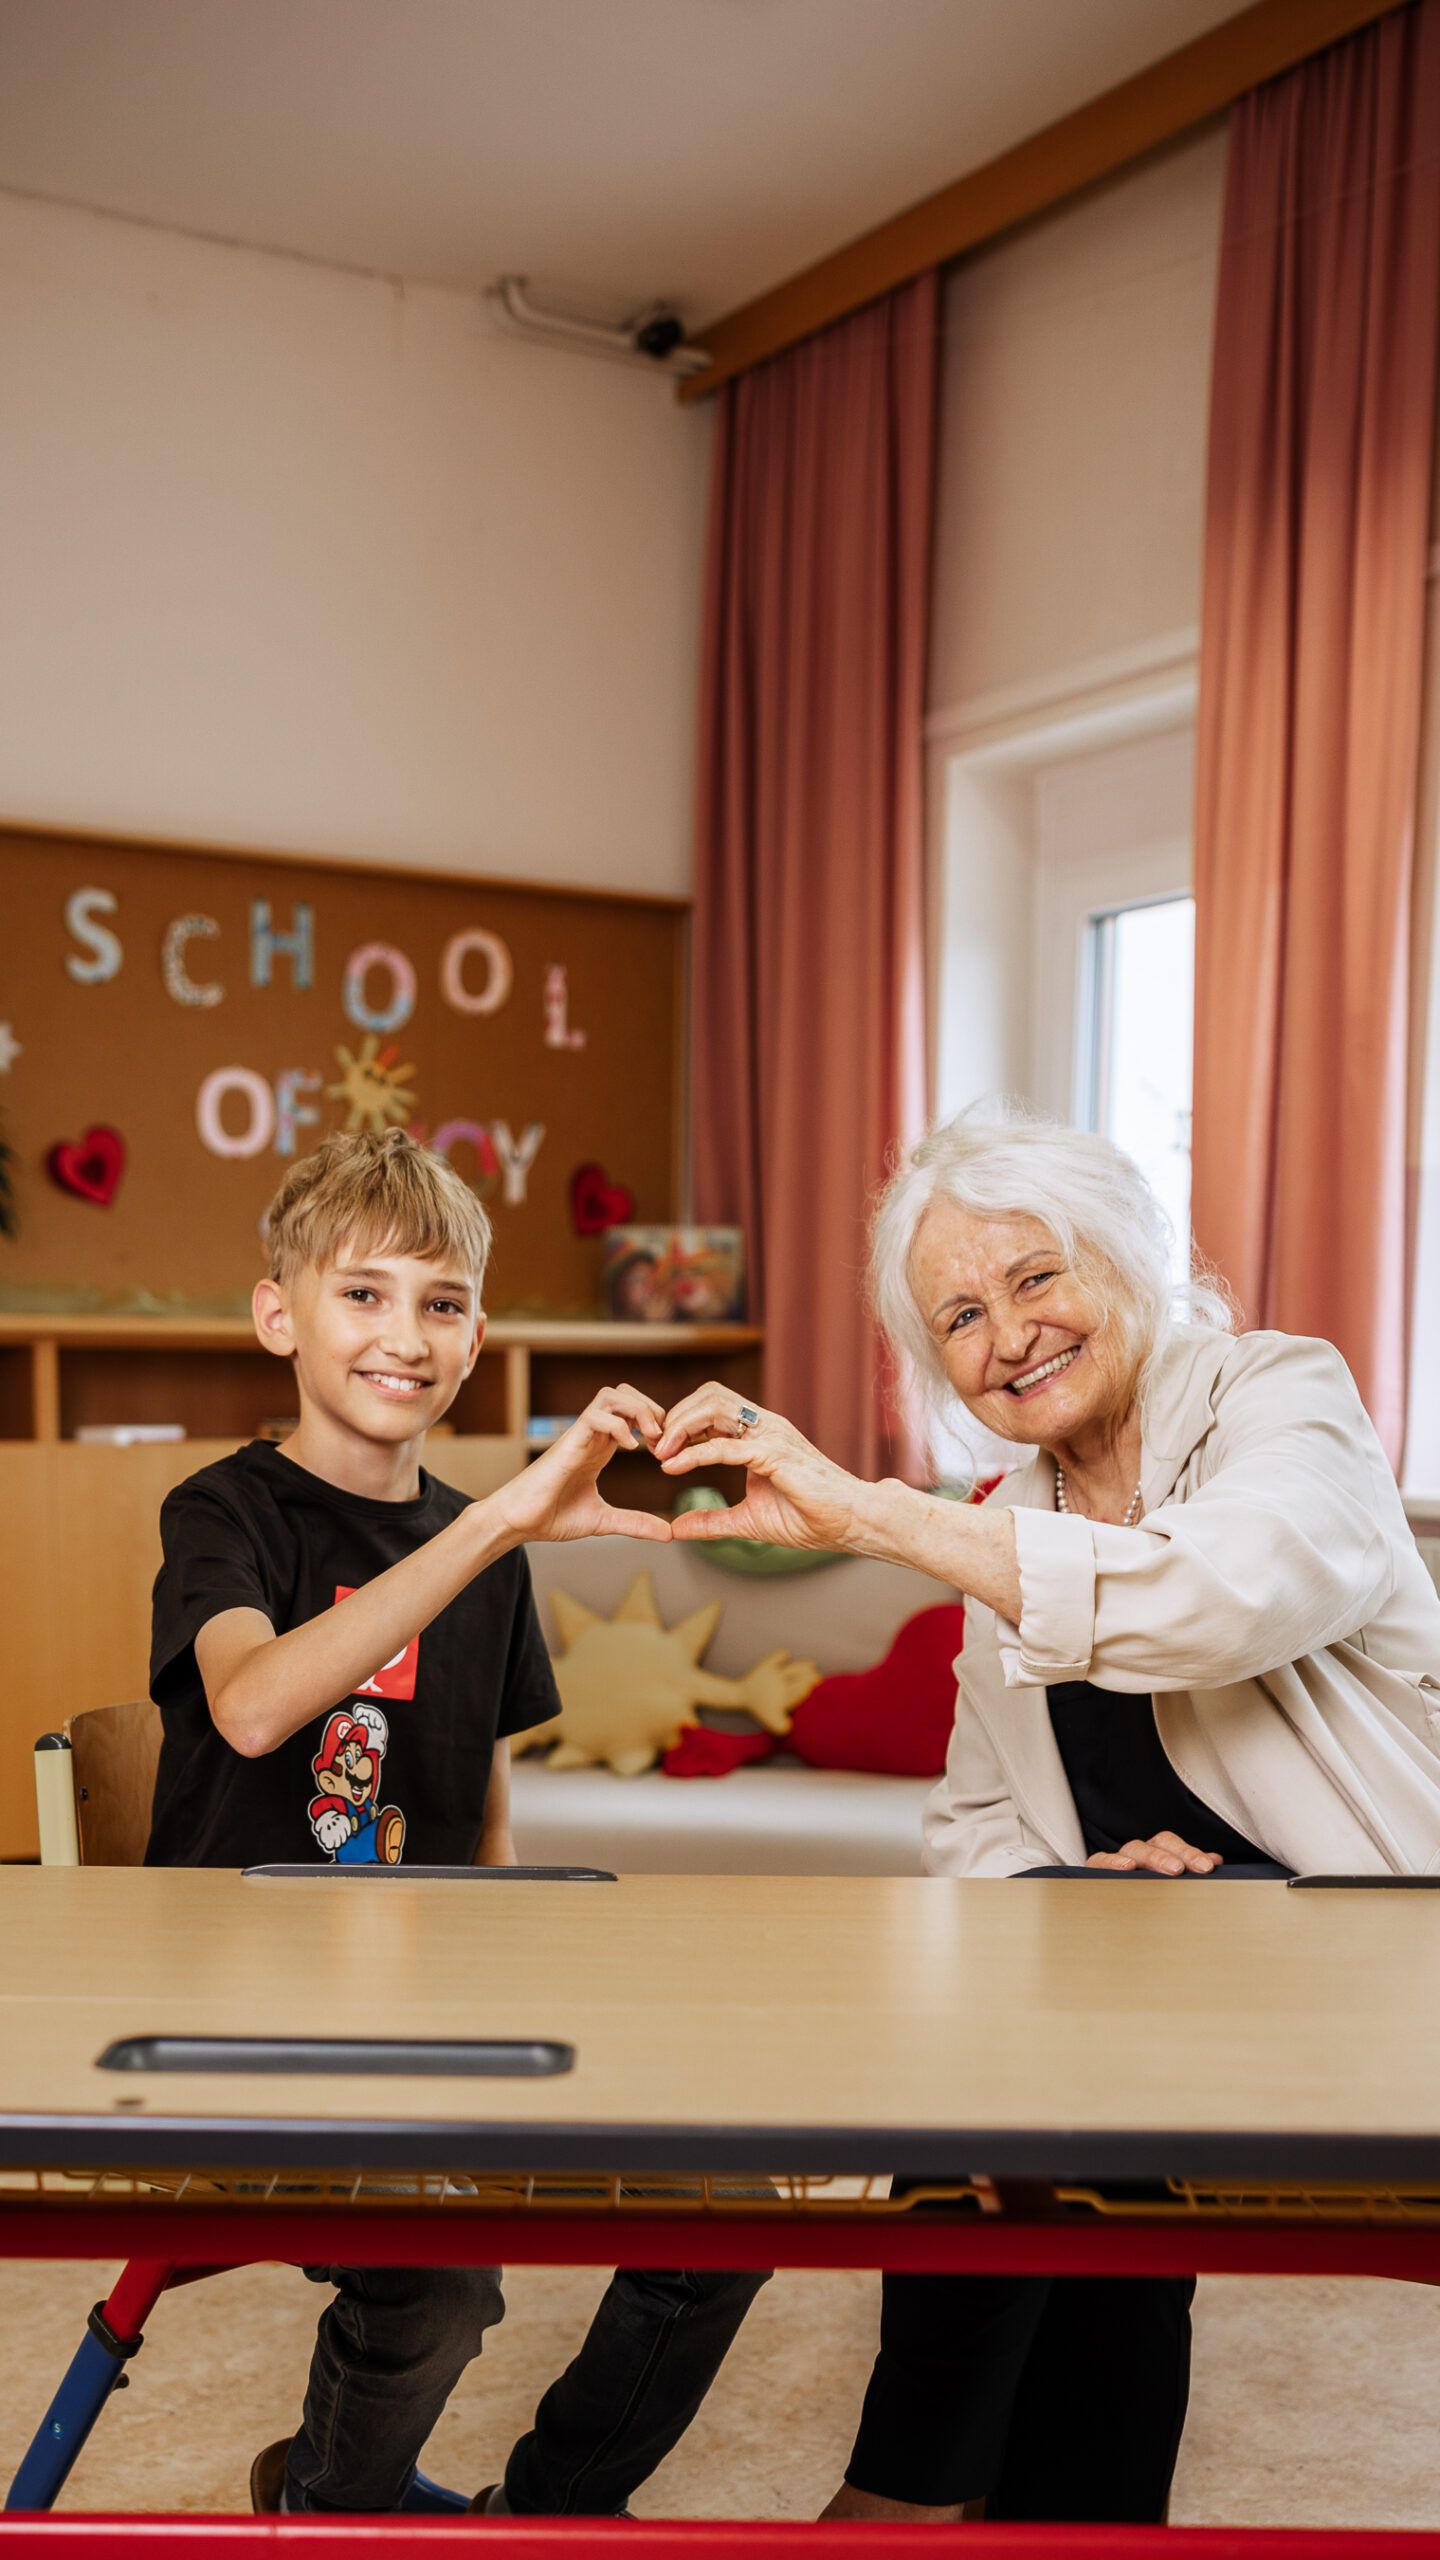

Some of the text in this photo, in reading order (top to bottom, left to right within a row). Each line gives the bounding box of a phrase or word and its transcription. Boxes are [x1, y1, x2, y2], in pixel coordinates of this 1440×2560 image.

[66, 886, 587, 1050] SCHOOL
[196, 1065, 322, 1159] OF
[407, 1118, 546, 1207] OY
